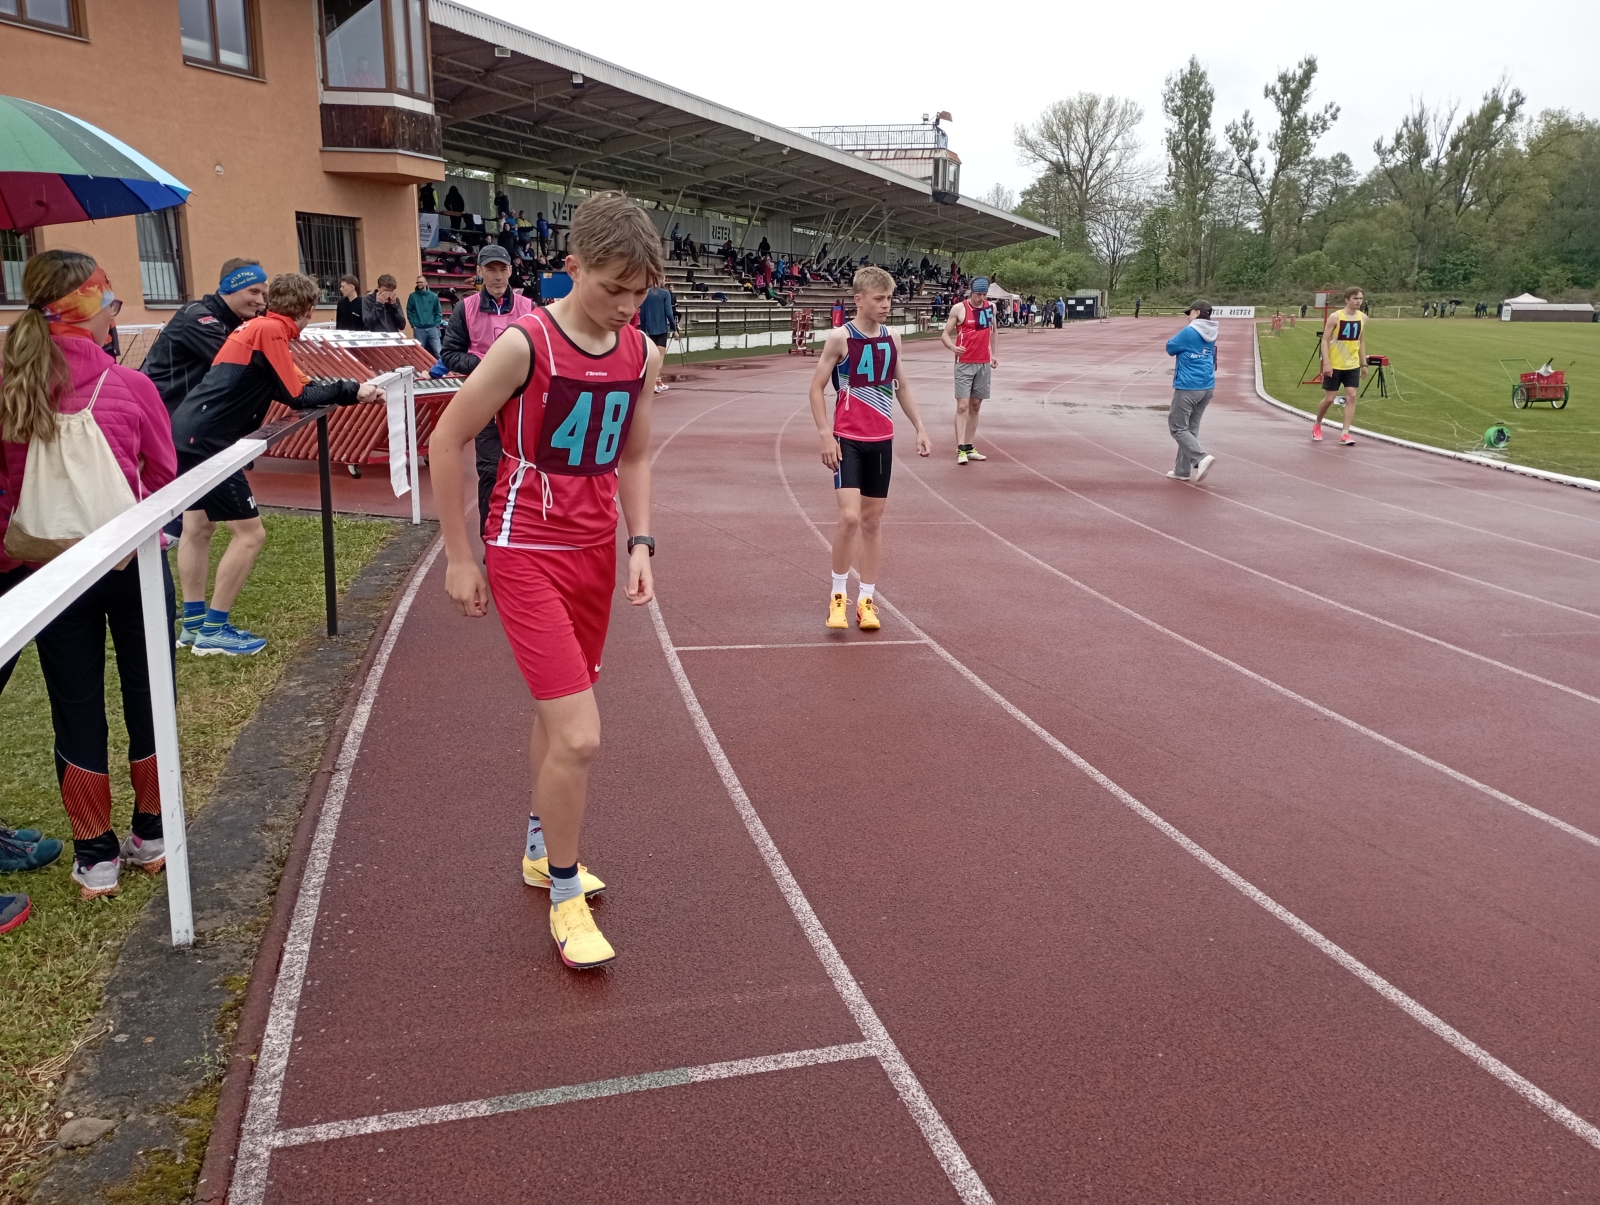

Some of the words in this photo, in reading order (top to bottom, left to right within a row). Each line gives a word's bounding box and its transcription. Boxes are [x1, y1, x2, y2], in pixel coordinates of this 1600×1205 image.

[711, 225, 731, 240] RIETER
[979, 307, 994, 328] 45
[1342, 322, 1359, 339] 41
[856, 342, 892, 382] 47
[550, 391, 630, 466] 48
